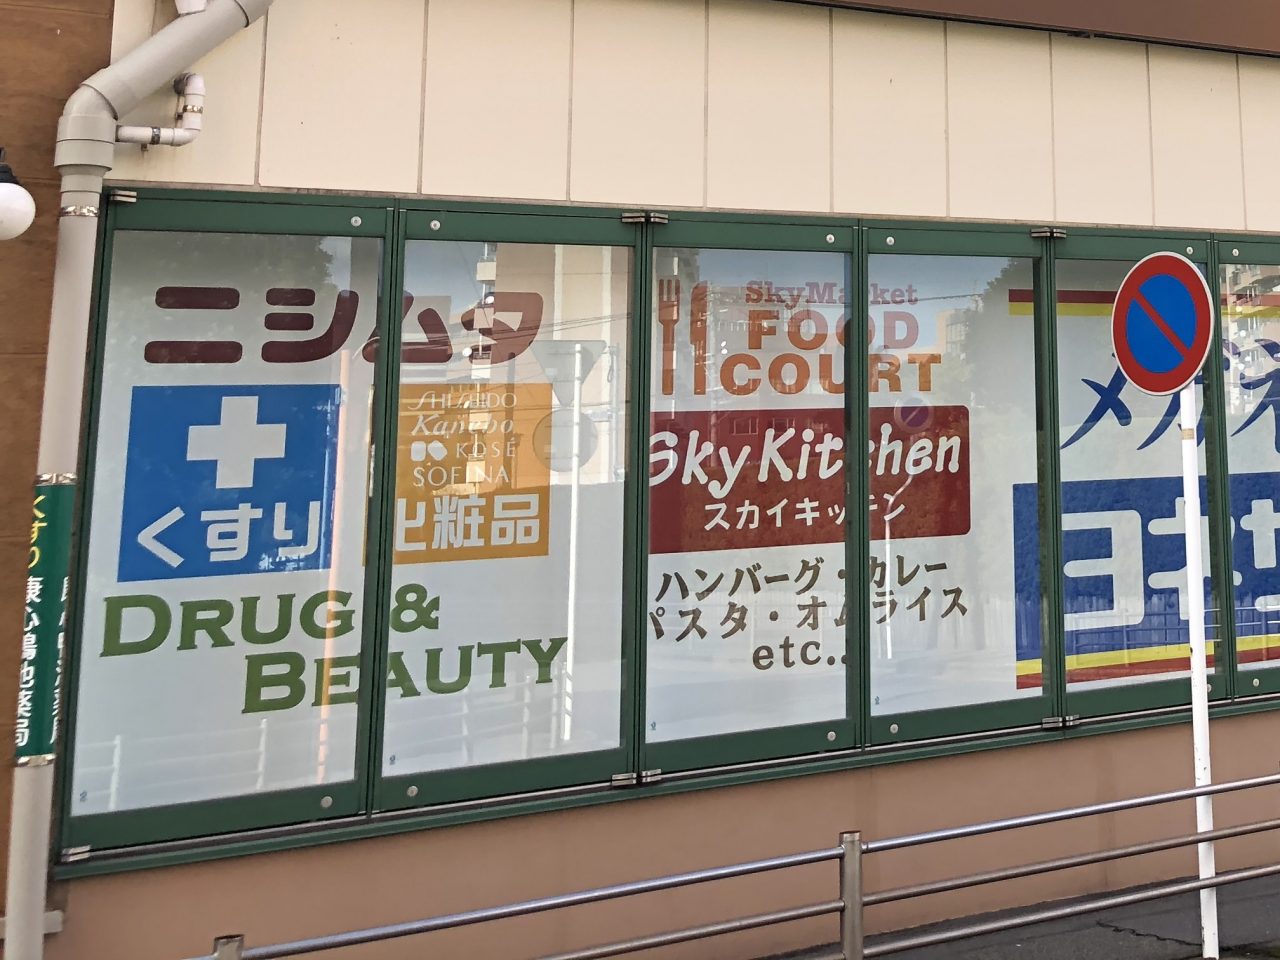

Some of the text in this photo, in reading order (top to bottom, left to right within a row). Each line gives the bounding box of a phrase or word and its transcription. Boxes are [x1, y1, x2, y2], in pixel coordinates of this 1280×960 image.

[144, 286, 543, 364] ニシムタ
[720, 353, 941, 395] COURT
[413, 465, 509, 487] SOFNA
[138, 500, 320, 568] くすり
[100, 583, 439, 657] DRUG &
[242, 637, 567, 714] BEAUTY
